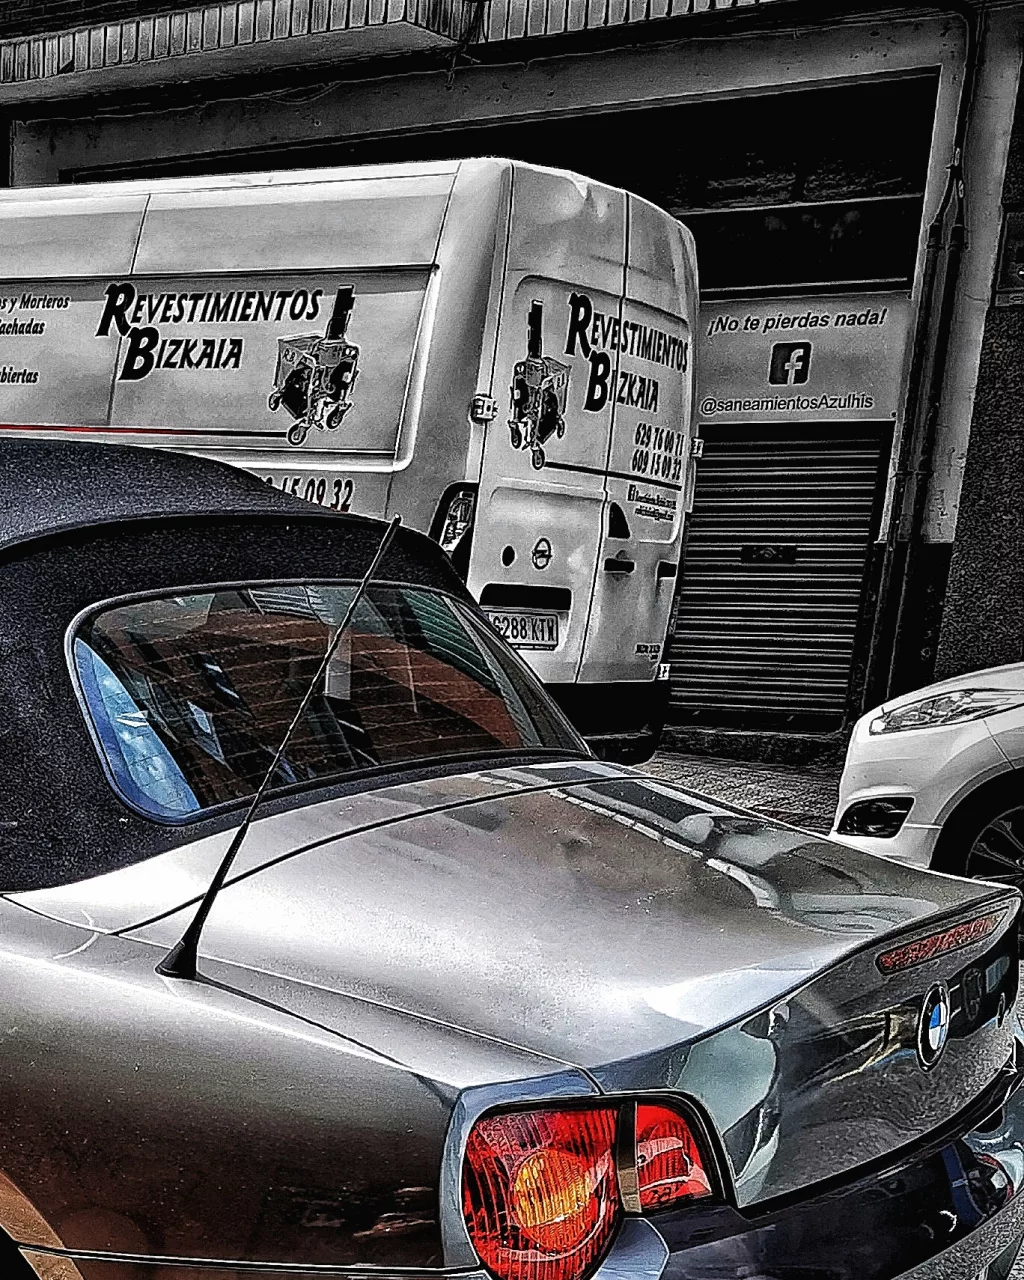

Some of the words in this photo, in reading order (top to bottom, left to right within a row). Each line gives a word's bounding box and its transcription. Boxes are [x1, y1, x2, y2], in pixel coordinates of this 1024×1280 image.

[8, 297, 17, 313] y
[19, 293, 70, 309] Morteros
[95, 283, 323, 337] REVESTIMIENTOS
[564, 292, 688, 373] REVESTIMIENTOS
[707, 317, 739, 336] ¡No
[743, 316, 760, 330] te
[762, 312, 830, 333] pierdas
[834, 308, 888, 326] nada!
[118, 326, 243, 381] BIZKAIA
[583, 349, 658, 413] BIZKAIA
[700, 393, 874, 416] @saneamientosAzulhis
[636, 423, 652, 448] 629
[632, 449, 649, 474] 609
[650, 453, 662, 475] 15
[330, 479, 354, 512] 32
